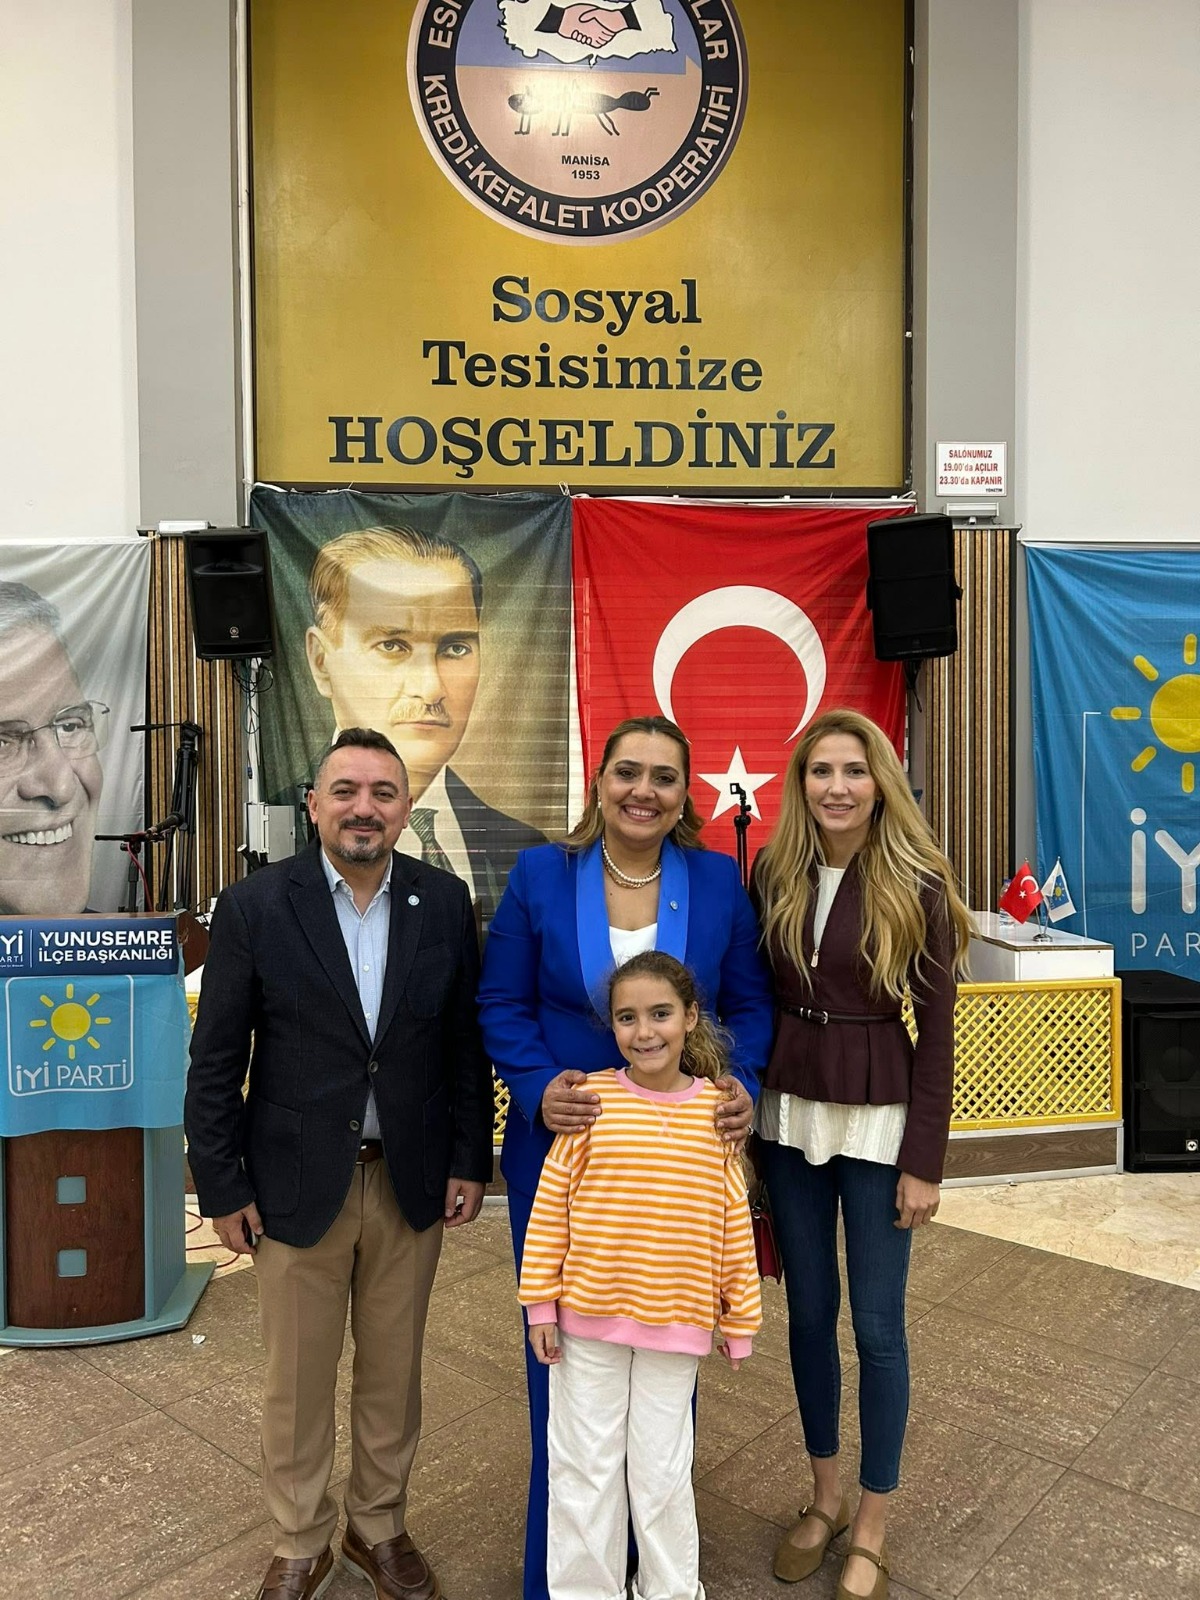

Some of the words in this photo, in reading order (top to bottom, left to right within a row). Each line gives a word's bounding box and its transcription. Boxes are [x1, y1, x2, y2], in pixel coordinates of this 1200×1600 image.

[688, 0, 729, 61] LAR
[423, 74, 594, 229] KREDİ-KEFALET
[601, 84, 734, 228] KOOPERATİFİ
[561, 154, 610, 166] MANİSA
[571, 170, 600, 181] 1953
[492, 275, 702, 337] Sosyal
[422, 340, 763, 392] Tesisimize
[328, 408, 836, 478] HOŞGELDİNİZ
[949, 450, 992, 458] SALONUMUZ
[943, 463, 973, 471] 19.00'da
[974, 463, 998, 474] AÇILIR
[939, 476, 969, 484] 23.30'da
[970, 476, 1002, 484] KAPANIR
[39, 929, 173, 947] YUNUSEMRE
[39, 948, 73, 964] İLÇE
[77, 946, 172, 964] BAŞKANLIĞI
[16, 1061, 50, 1091] İYİ
[56, 1058, 128, 1087] PARTİ
